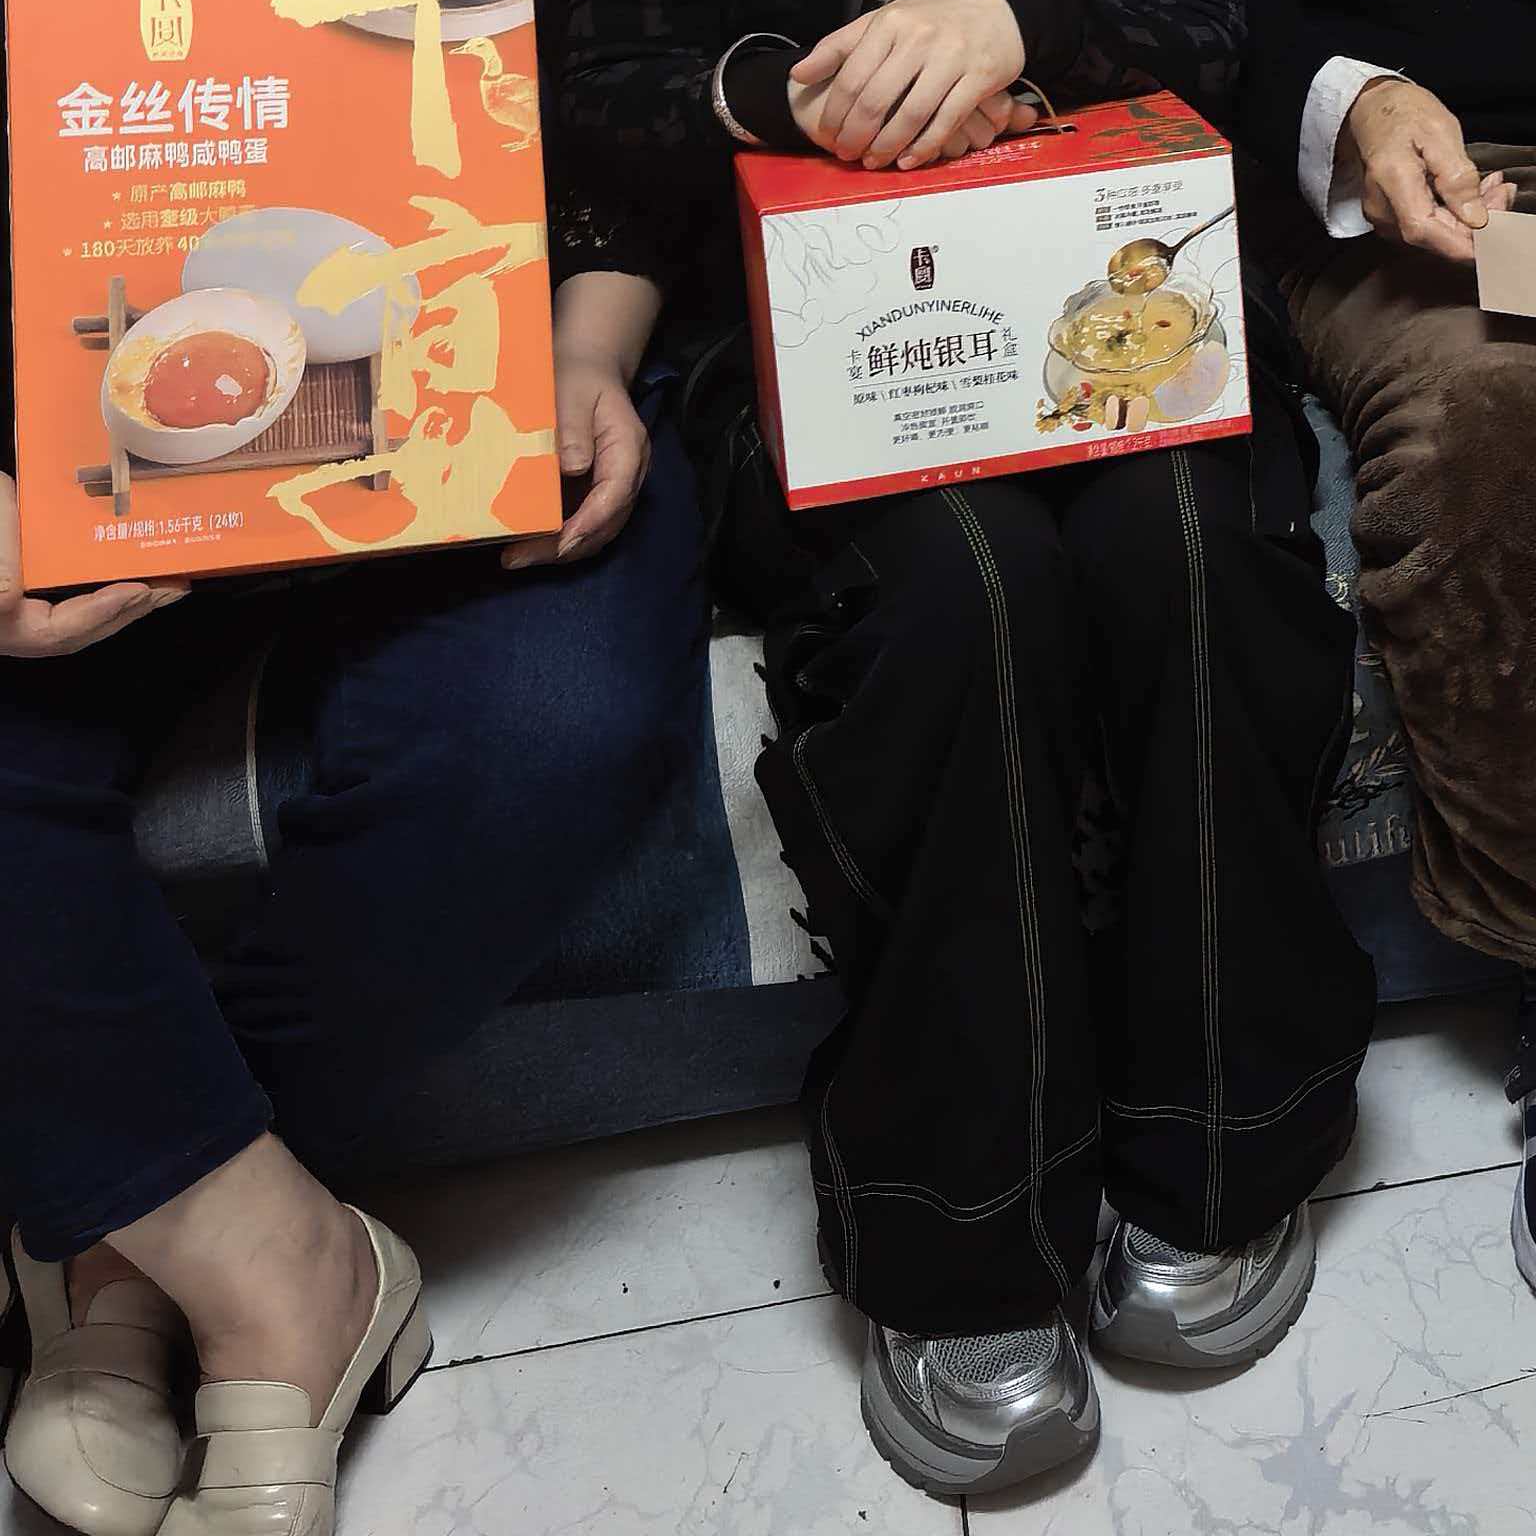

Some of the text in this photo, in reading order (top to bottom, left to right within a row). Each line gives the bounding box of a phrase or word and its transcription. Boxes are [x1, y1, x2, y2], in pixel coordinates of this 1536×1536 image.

[57, 76, 291, 137] 金丝传情
[83, 137, 269, 172] 高邮麻鸭咸鸭蛋
[856, 299, 1005, 342] XIANDUNYINERLIHE
[867, 329, 998, 377] 鲜炖银耳
